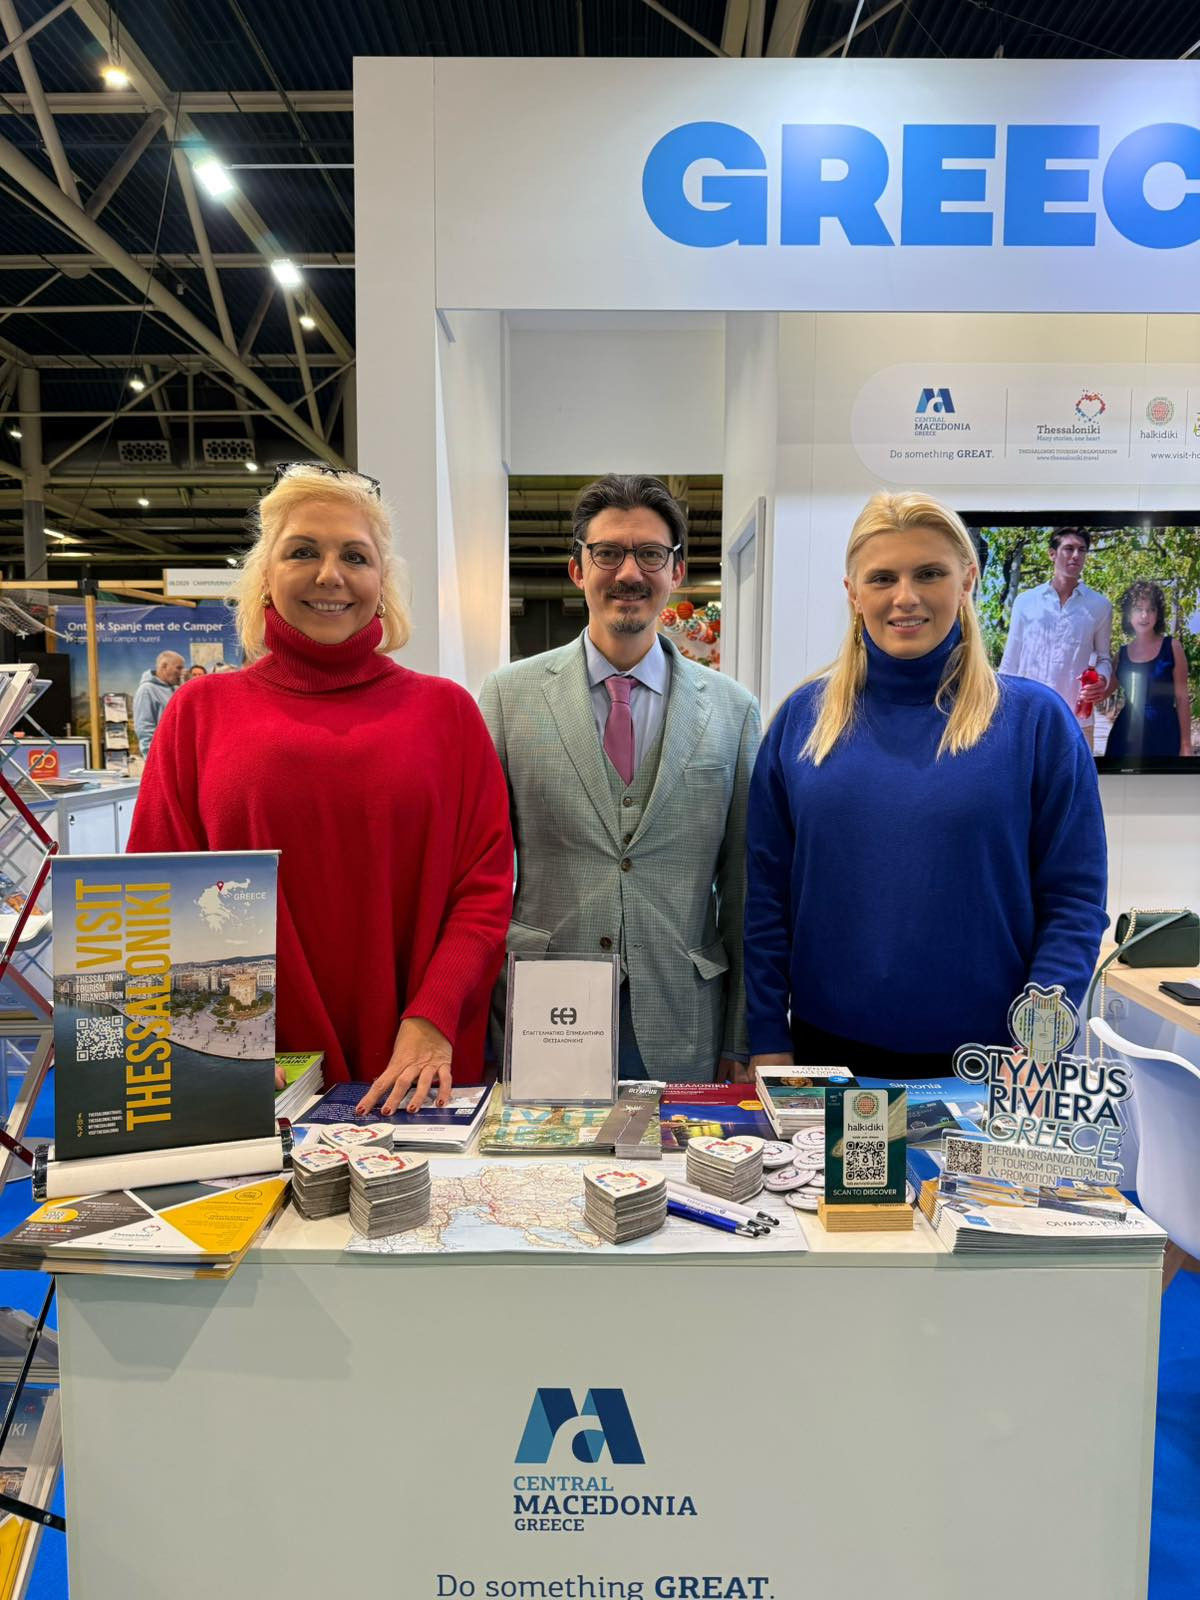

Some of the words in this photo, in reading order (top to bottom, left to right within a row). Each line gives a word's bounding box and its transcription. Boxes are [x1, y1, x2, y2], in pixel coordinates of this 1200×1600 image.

[642, 121, 1200, 249] GREEC
[914, 423, 971, 431] MACEDONIA
[1037, 424, 1101, 434] Thessaloniki
[1140, 430, 1178, 439] halkidiki
[890, 450, 902, 458] Do
[905, 449, 954, 460] something
[957, 449, 994, 458] GREAT.
[68, 622, 105, 631] Ontek
[108, 622, 142, 633] Spanje
[145, 622, 165, 631] met
[167, 622, 181, 631] de
[183, 622, 223, 633] Camper
[234, 892, 266, 901] GREECE
[75, 879, 123, 968] VISIT
[75, 973, 123, 984] THESSALONIKI
[76, 983, 106, 993] TOURISM
[76, 992, 124, 1001] ORGANISATION
[125, 883, 172, 1132] THESSALONIKI
[957, 1048, 1128, 1098] OLYMPUS
[989, 1084, 1119, 1127] RIVIERA
[848, 1123, 884, 1131] halkidiki
[987, 1114, 1122, 1158] GREECE
[987, 1144, 1025, 1158] PIERIAN
[1026, 1149, 1097, 1168] ORGANIZATION
[987, 1155, 999, 1165] OF
[1001, 1158, 1044, 1172] TOURISM
[1046, 1164, 1117, 1183] DEVELOPMENT
[1001, 1170, 1057, 1186] PROMOTION
[513, 1475, 614, 1492] CENTRAL
[513, 1494, 698, 1516] MACEDONIA
[514, 1518, 585, 1532] GREECE
[437, 1574, 476, 1597] Do
[485, 1575, 644, 1600] something
[655, 1576, 775, 1599] GREAT.
